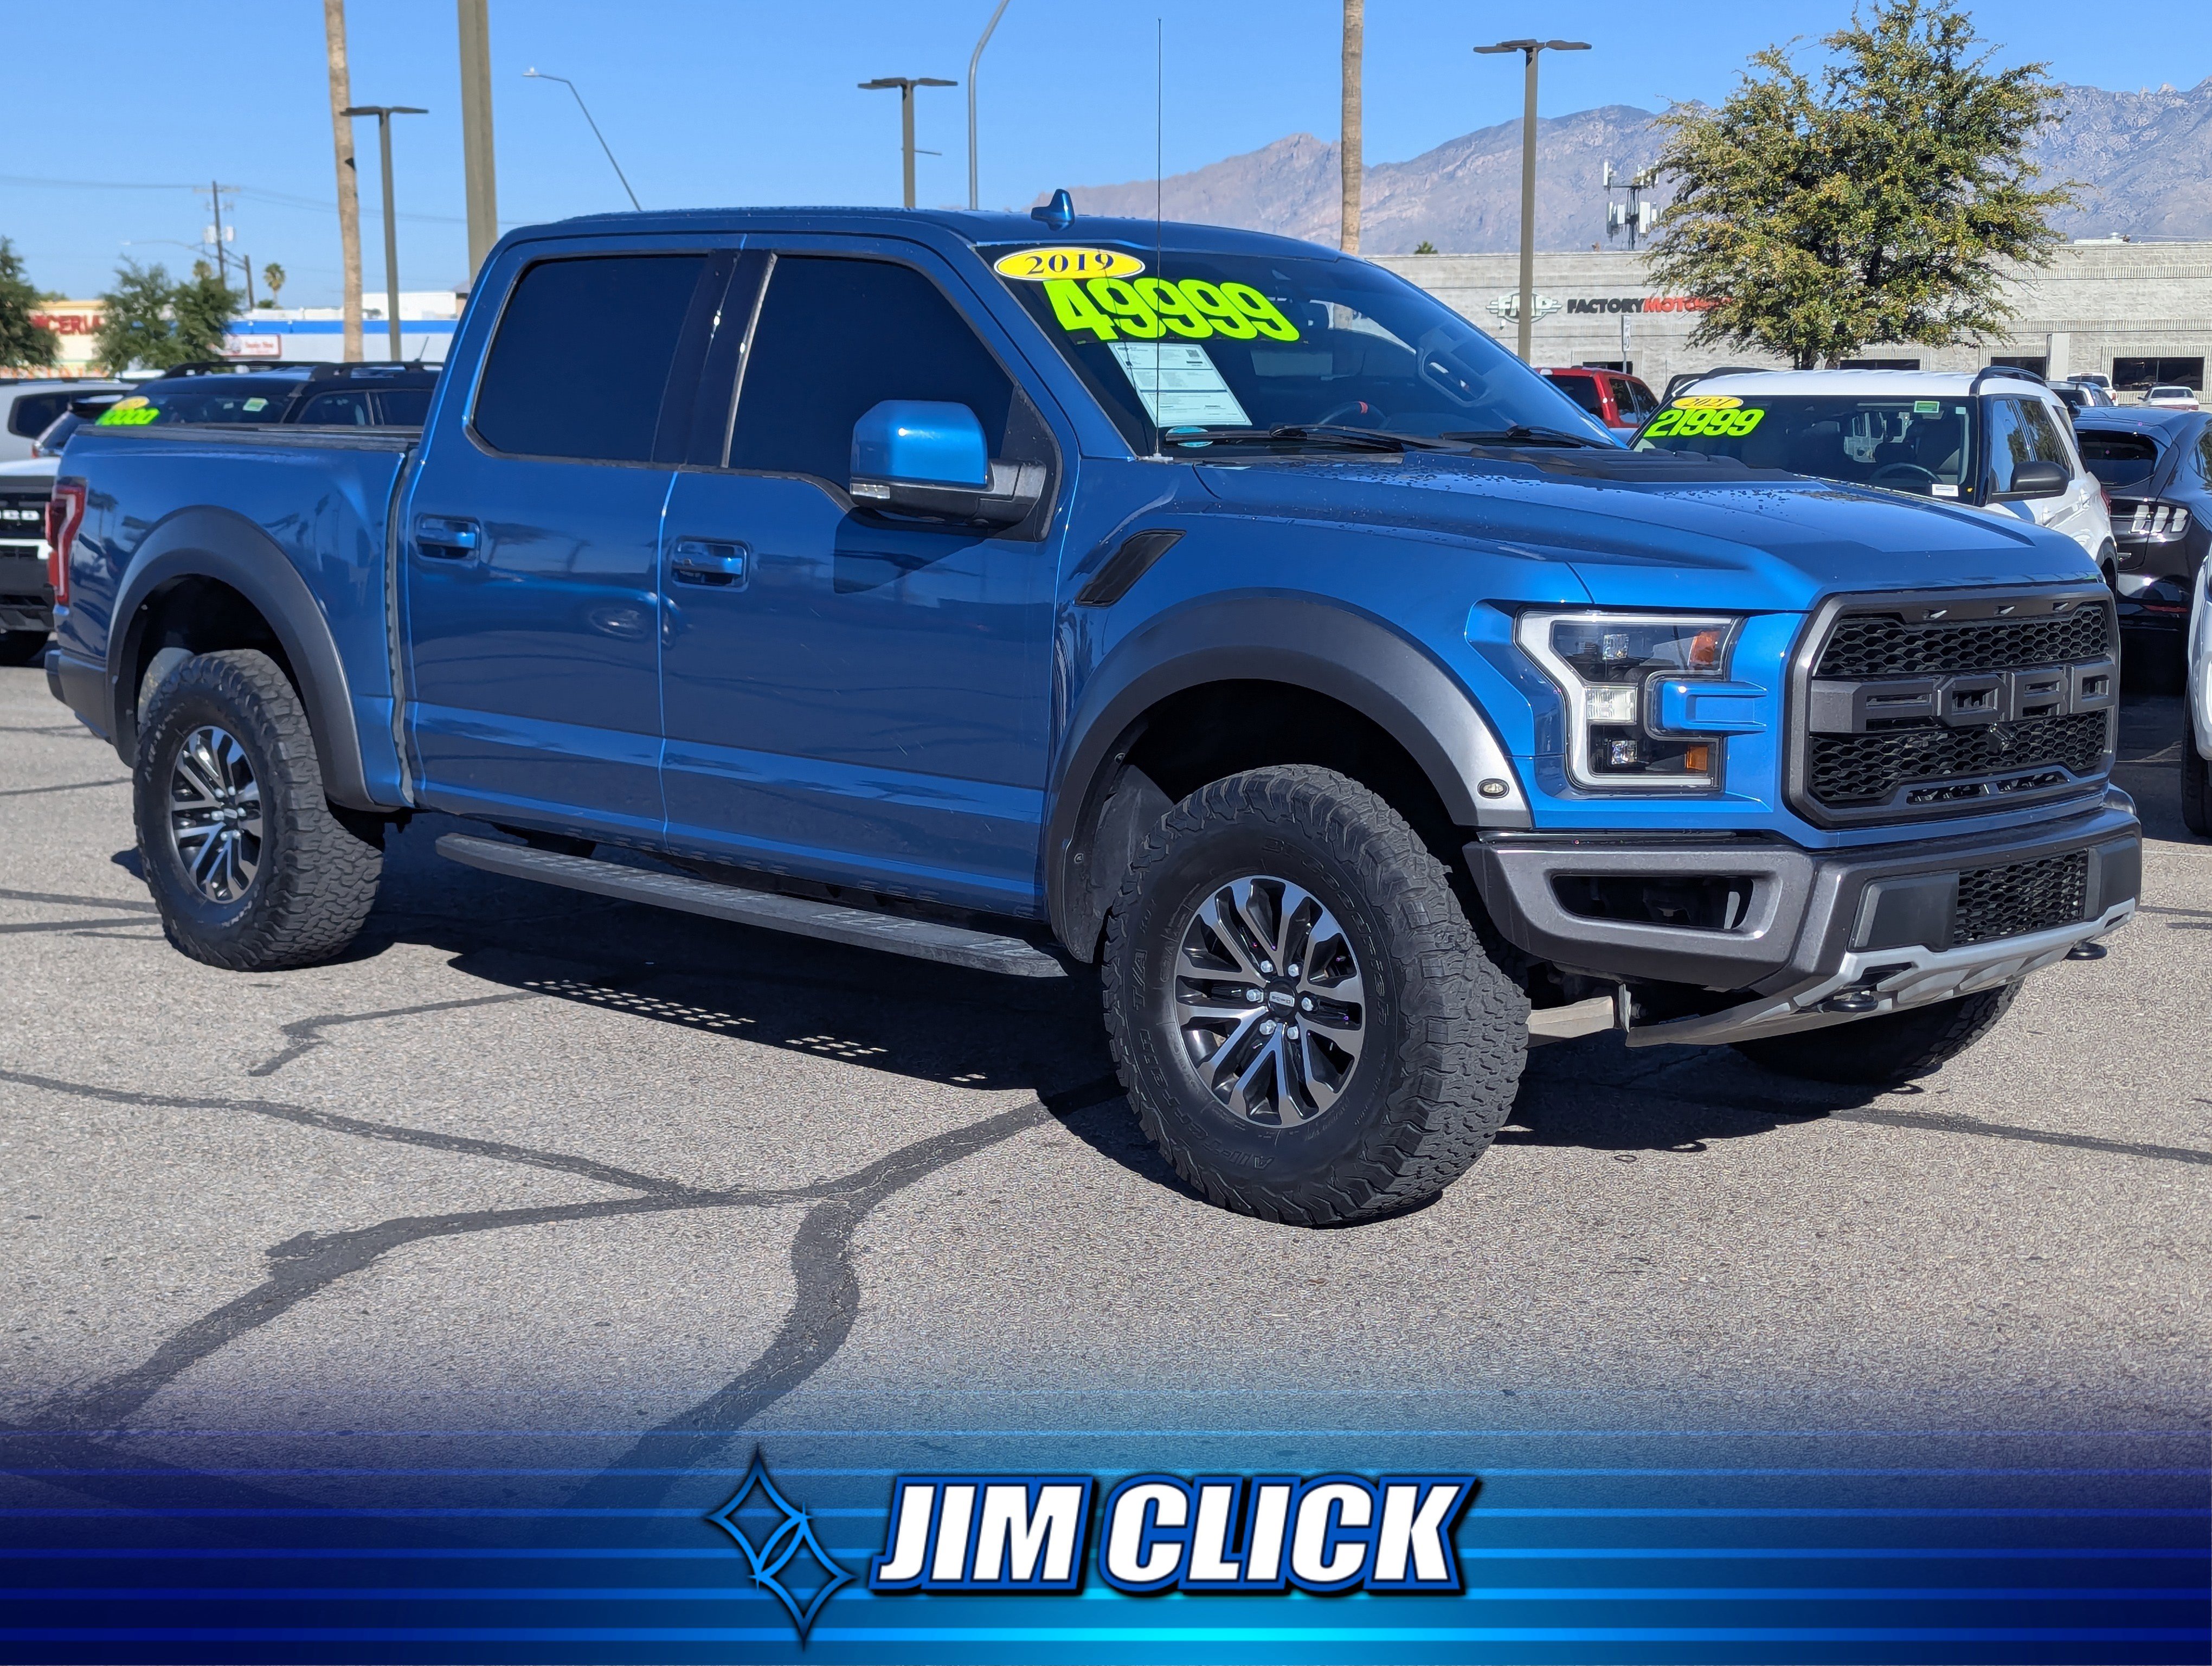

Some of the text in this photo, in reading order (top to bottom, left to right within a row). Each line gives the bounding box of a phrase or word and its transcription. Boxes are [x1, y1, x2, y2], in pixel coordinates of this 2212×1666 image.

[1024, 252, 1115, 275] 2019
[1042, 277, 1300, 341] 49999
[1643, 408, 1765, 437] 21999
[1852, 661, 2114, 733] FORD
